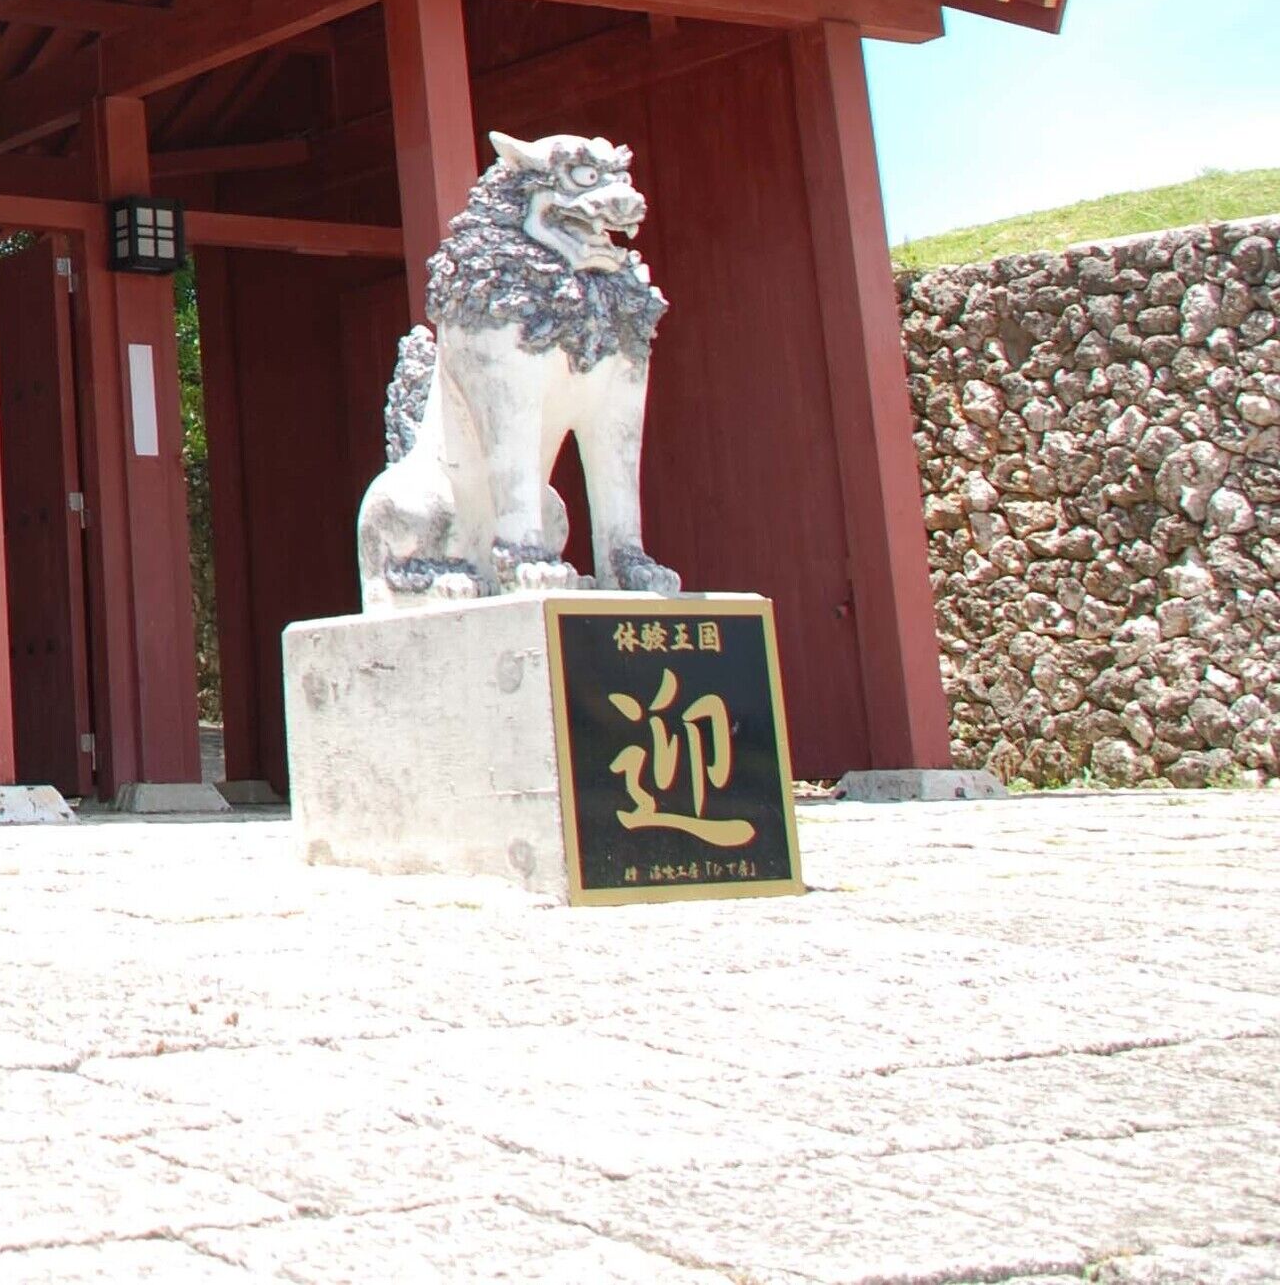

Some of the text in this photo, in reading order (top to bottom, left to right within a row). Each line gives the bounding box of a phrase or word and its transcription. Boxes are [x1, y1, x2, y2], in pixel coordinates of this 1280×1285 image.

[612, 620, 722, 653] 体験王国
[606, 667, 757, 848] 迎
